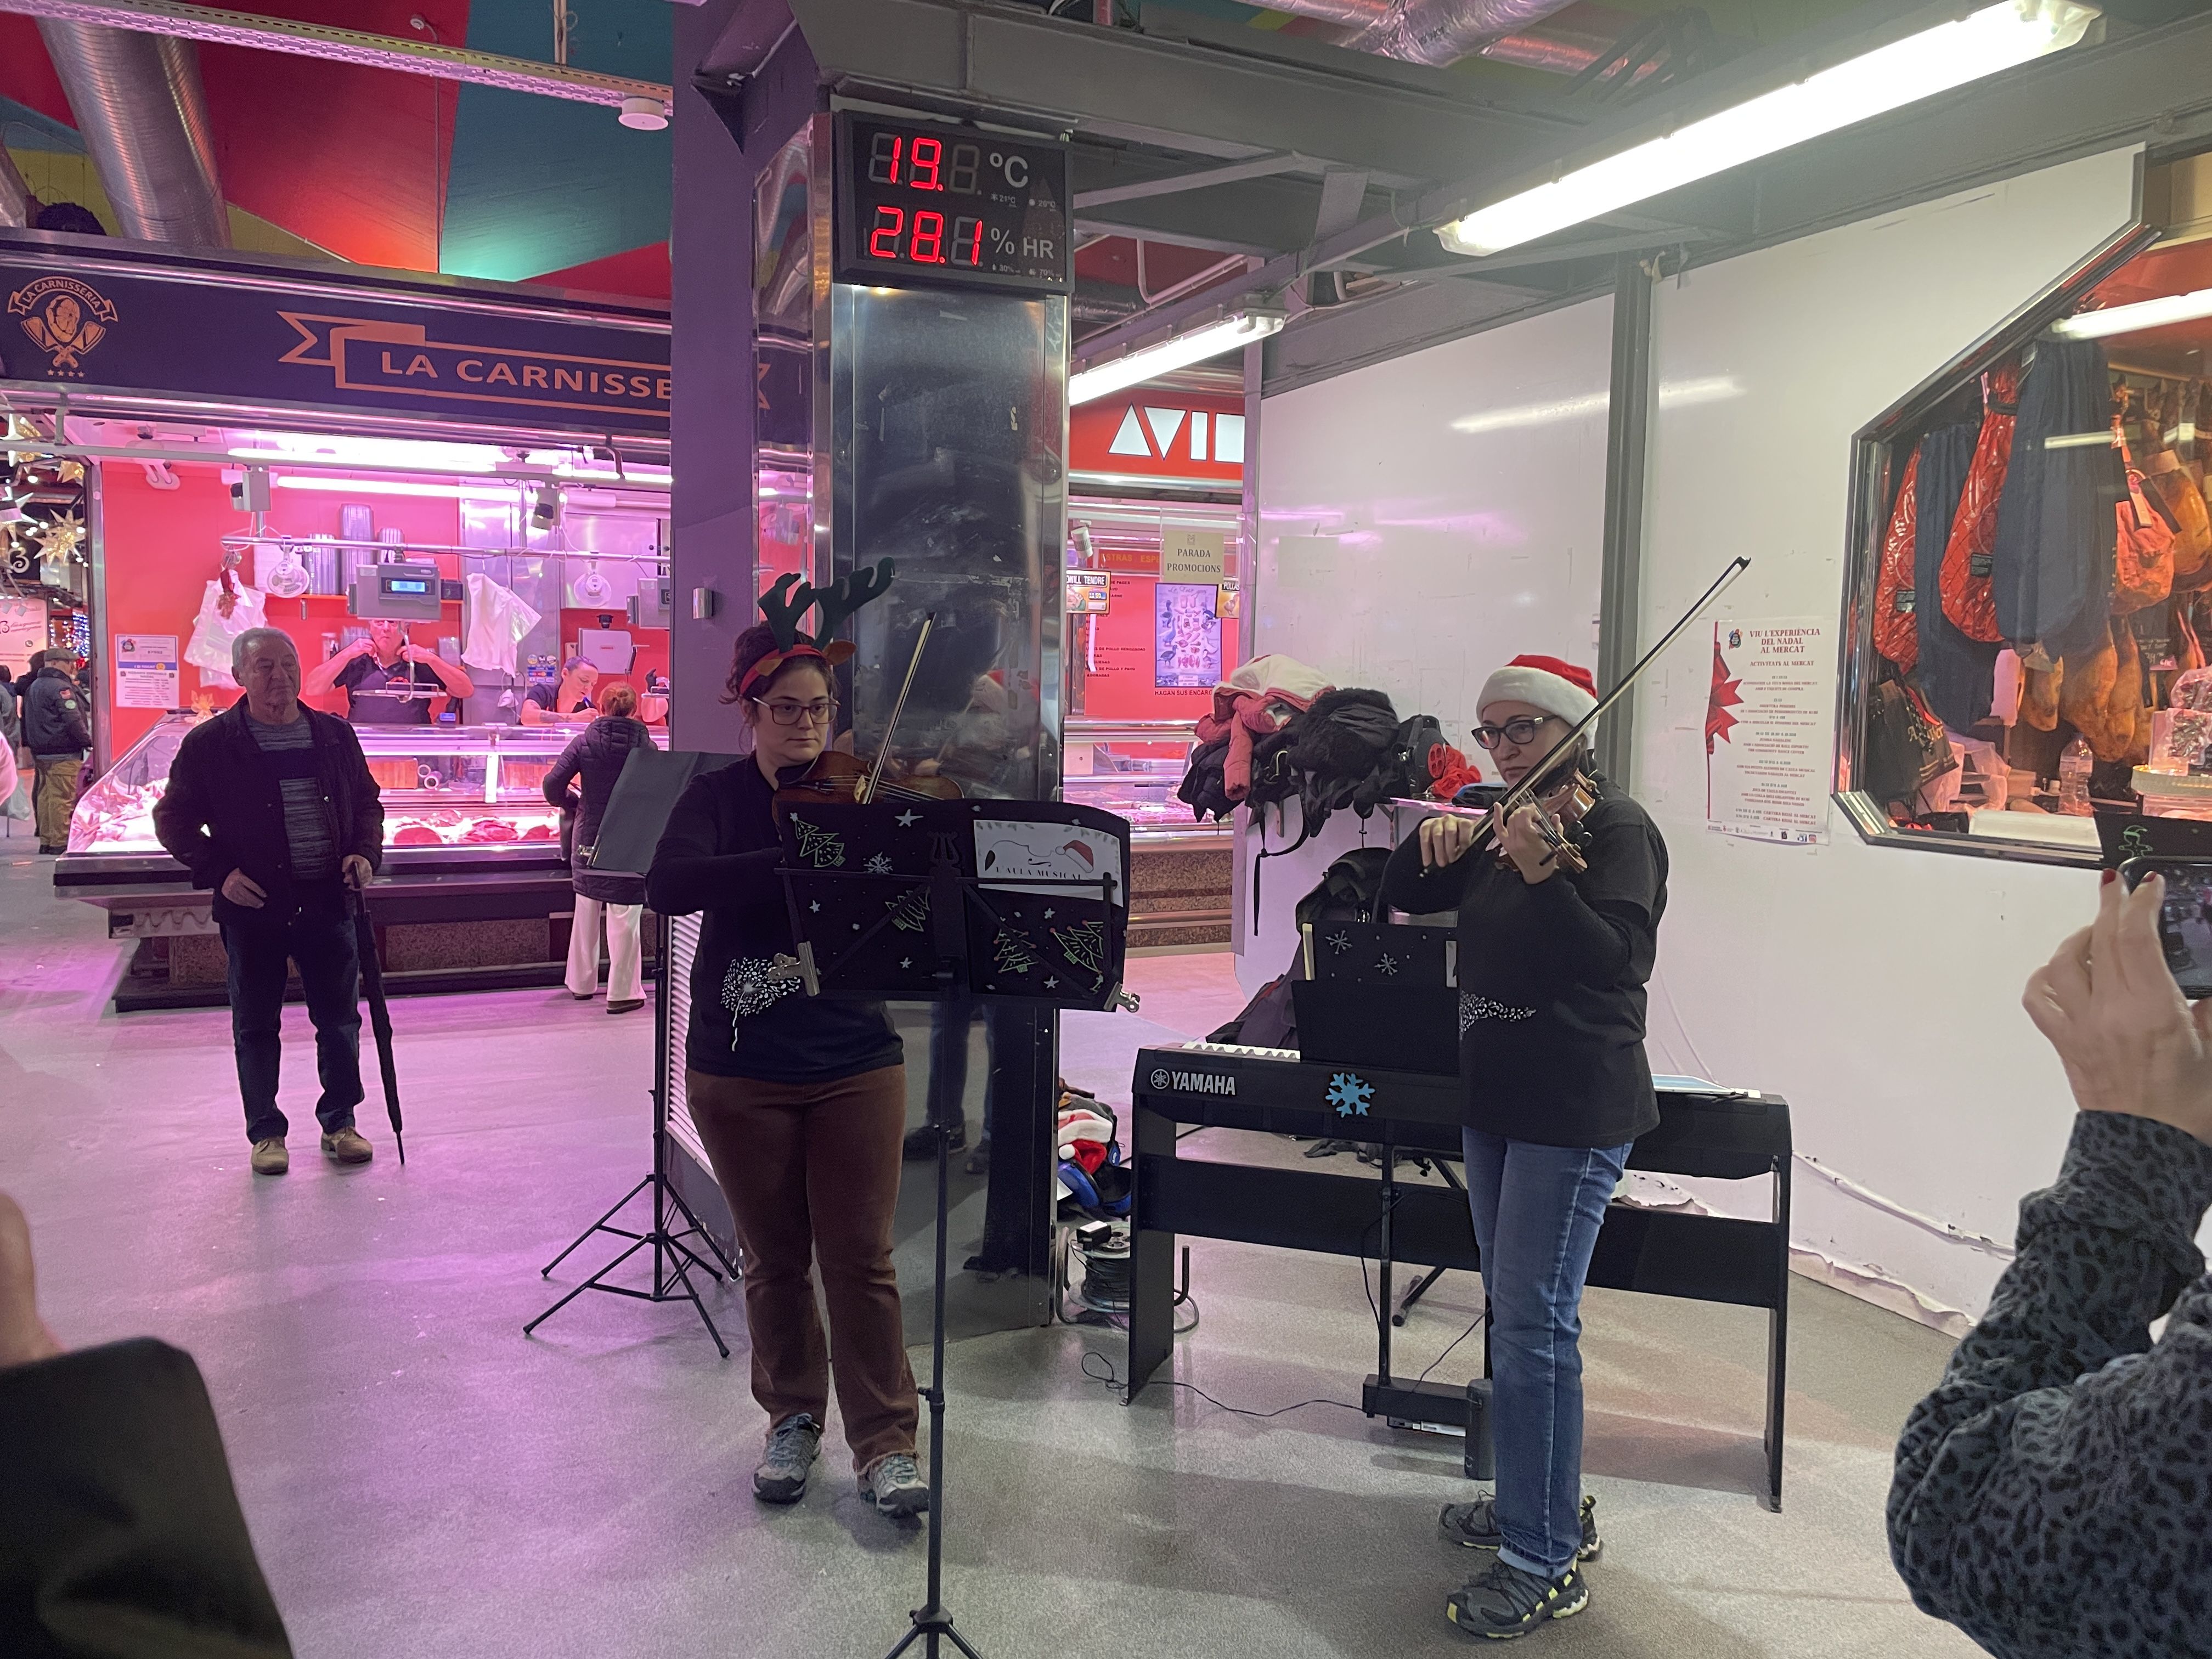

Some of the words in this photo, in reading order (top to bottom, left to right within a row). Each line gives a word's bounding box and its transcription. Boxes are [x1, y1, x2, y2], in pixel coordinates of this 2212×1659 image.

[870, 206, 983, 266] 28.1
[991, 228, 1015, 255] %
[1023, 237, 1053, 259] HR
[22, 292, 36, 303] LA
[35, 280, 101, 308] CARNISSERIA
[382, 352, 438, 378] LA
[456, 360, 672, 399] CARNISSE
[1177, 549, 1211, 557] PARADA
[1167, 563, 1221, 573] PROMOCIONS
[1084, 576, 1105, 585] TENDRE
[1764, 627, 1820, 637] L'EXPERIÈNCIA
[1172, 1071, 1235, 1095] YAMAHA
